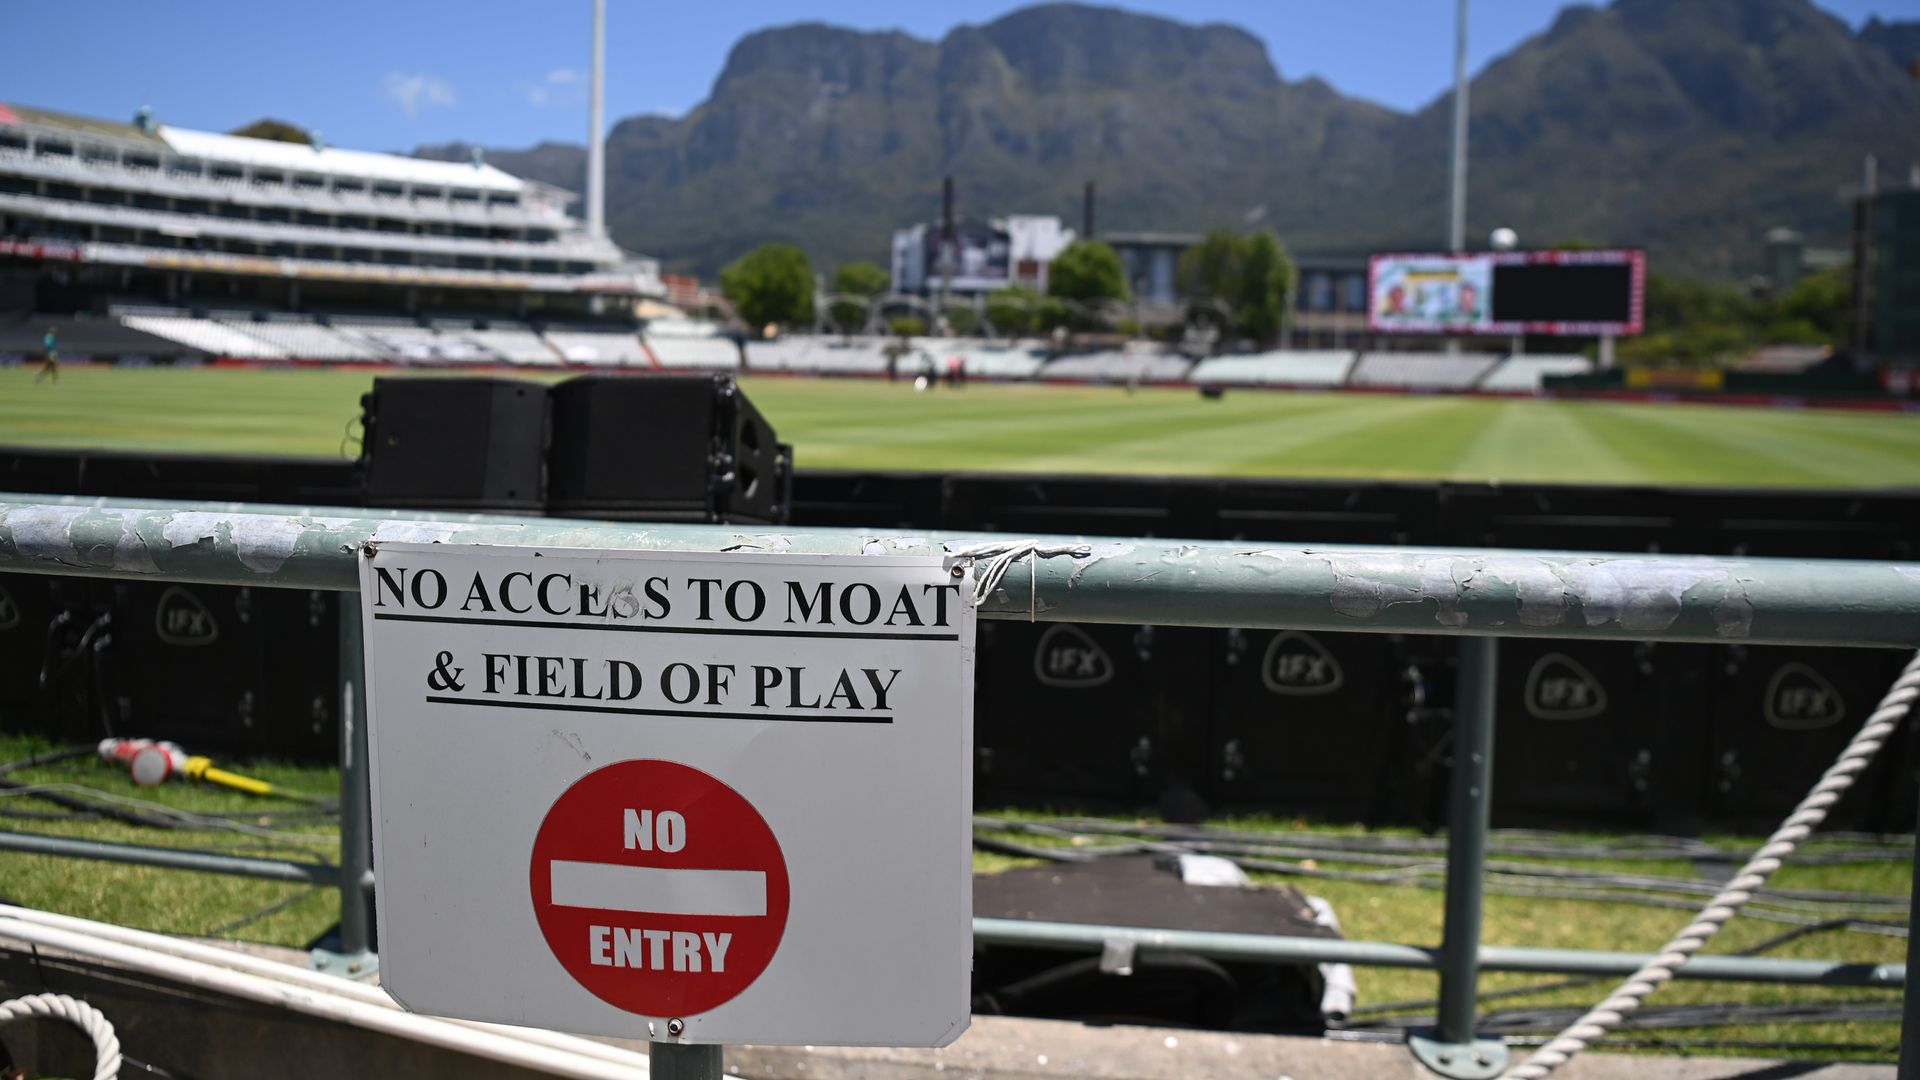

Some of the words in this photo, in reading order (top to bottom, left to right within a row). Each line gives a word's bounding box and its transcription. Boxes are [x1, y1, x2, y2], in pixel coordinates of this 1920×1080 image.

[373, 566, 448, 610] NO
[687, 578, 766, 623] TO
[783, 581, 960, 627] MOAT
[427, 650, 466, 692] &
[481, 653, 643, 701] FIELD
[660, 662, 736, 706] OF
[750, 665, 902, 711] PLAY
[1050, 648, 1097, 674] IFX
[1278, 654, 1325, 681] IFX
[623, 808, 687, 853] NO
[589, 924, 733, 973] ENTRY
